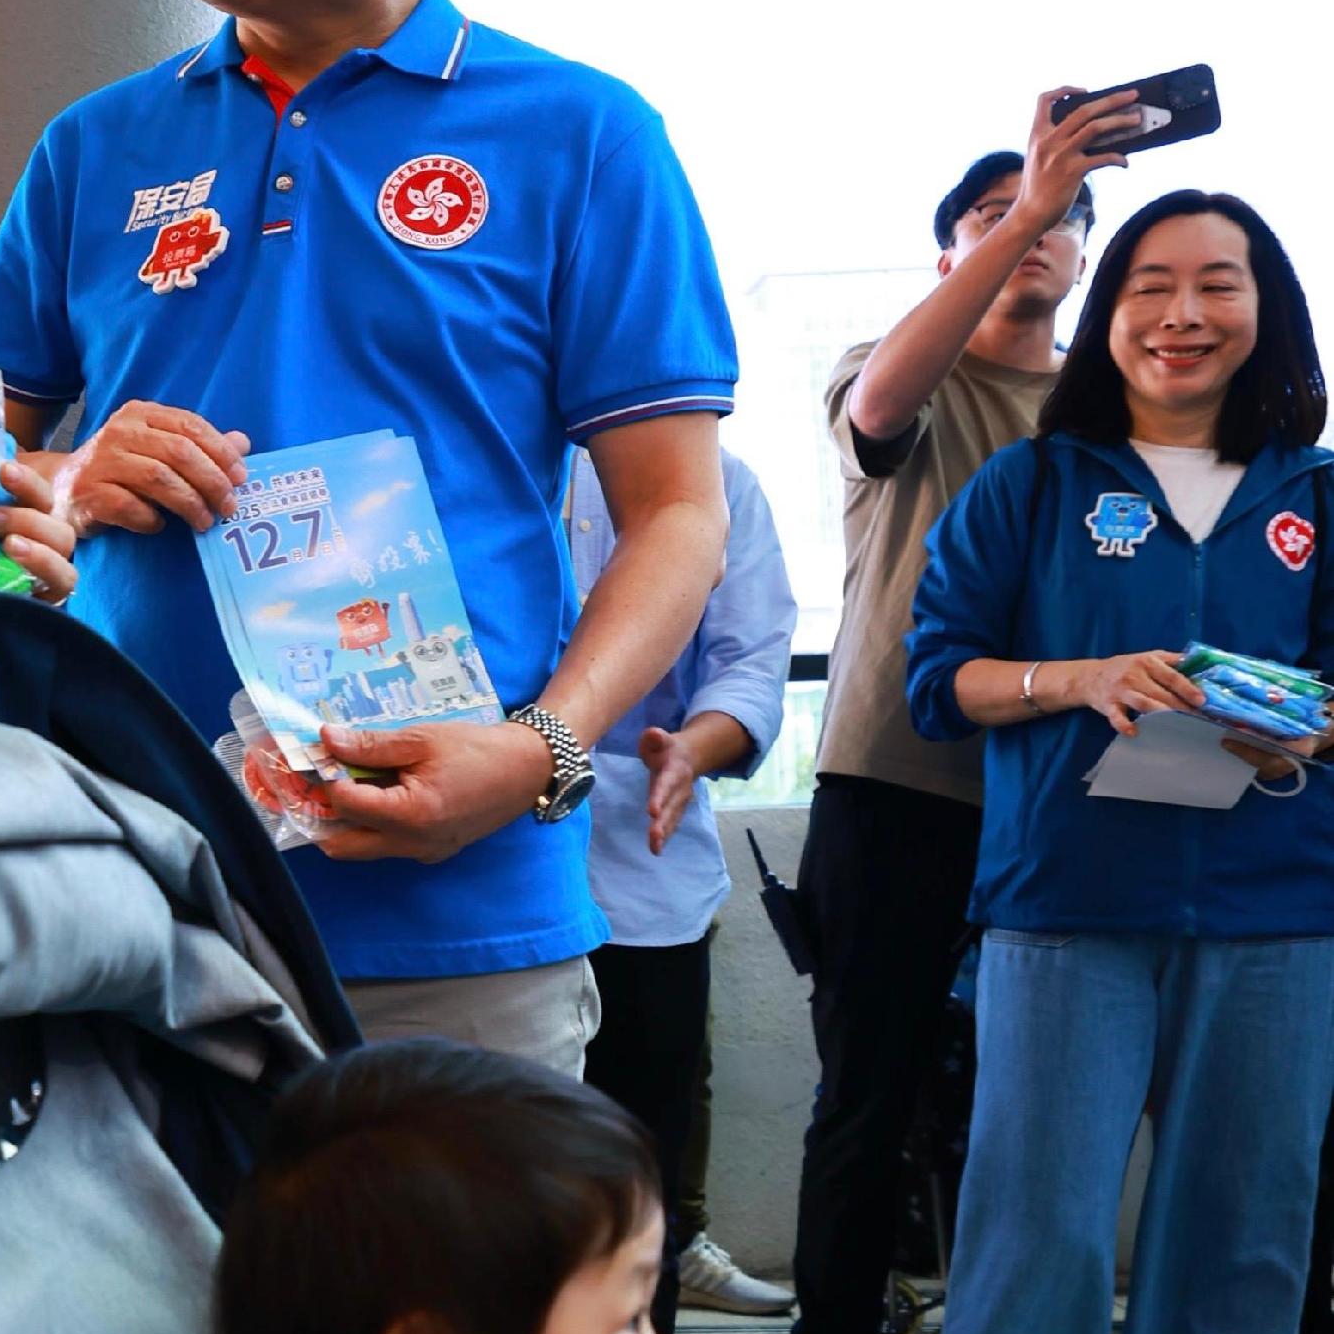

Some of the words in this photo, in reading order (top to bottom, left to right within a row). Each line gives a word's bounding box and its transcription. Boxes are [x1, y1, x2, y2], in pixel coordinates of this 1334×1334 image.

[123, 169, 217, 233] 保安局
[395, 223, 423, 241] HONG
[425, 235, 455, 245] KONG
